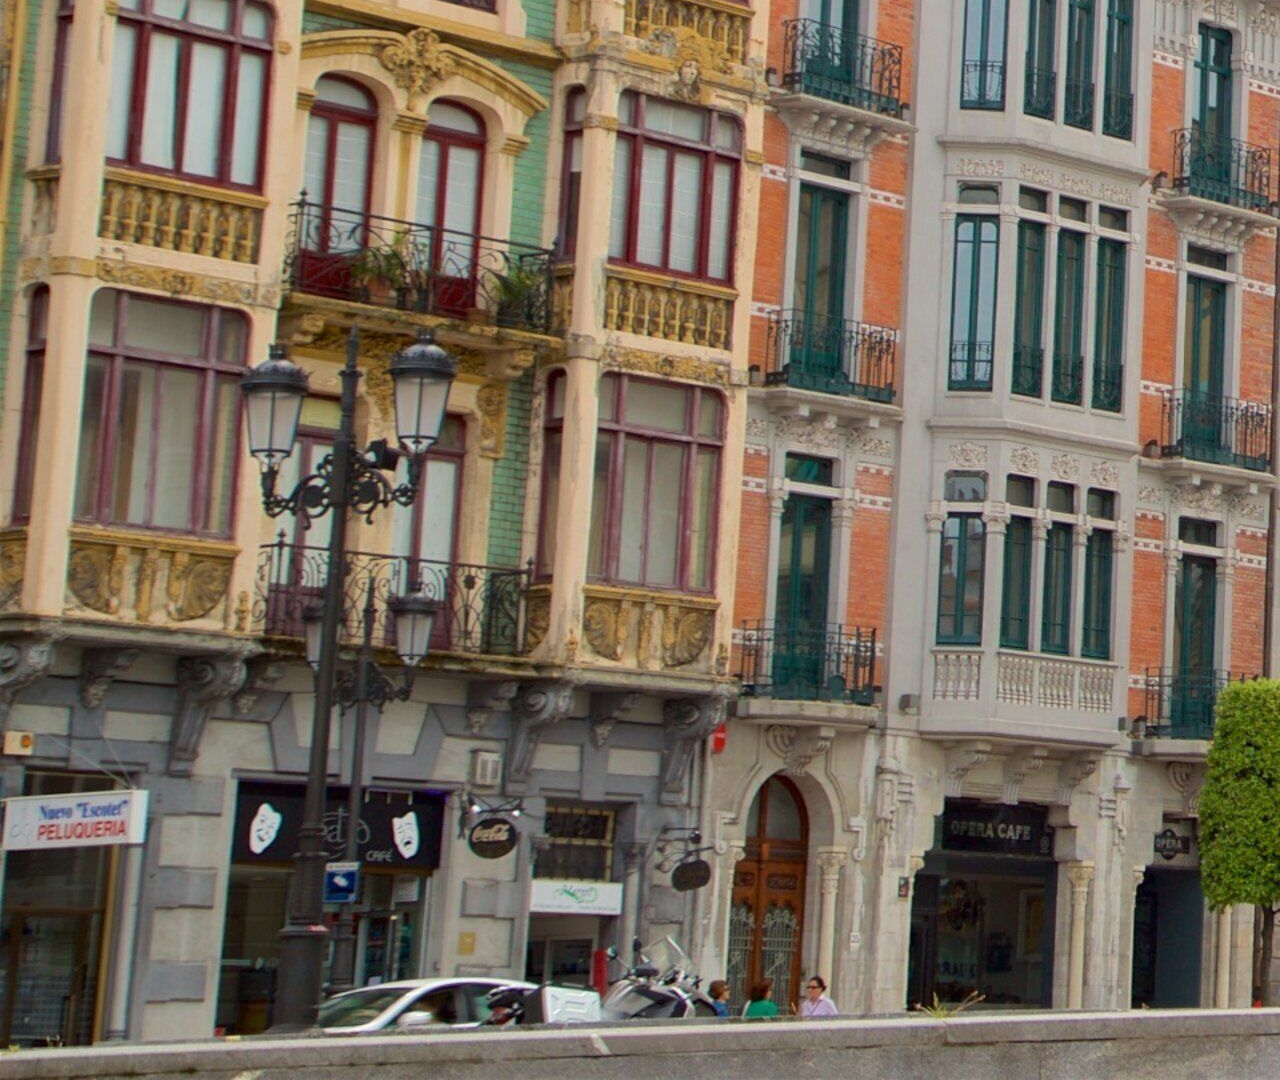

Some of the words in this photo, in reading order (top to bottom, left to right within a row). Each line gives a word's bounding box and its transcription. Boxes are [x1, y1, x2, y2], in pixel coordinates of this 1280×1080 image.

[40, 804, 73, 820] Nuevo
[37, 821, 126, 840] PELUQUERIA
[951, 821, 994, 838] OPERA
[997, 823, 1032, 840] CAFE
